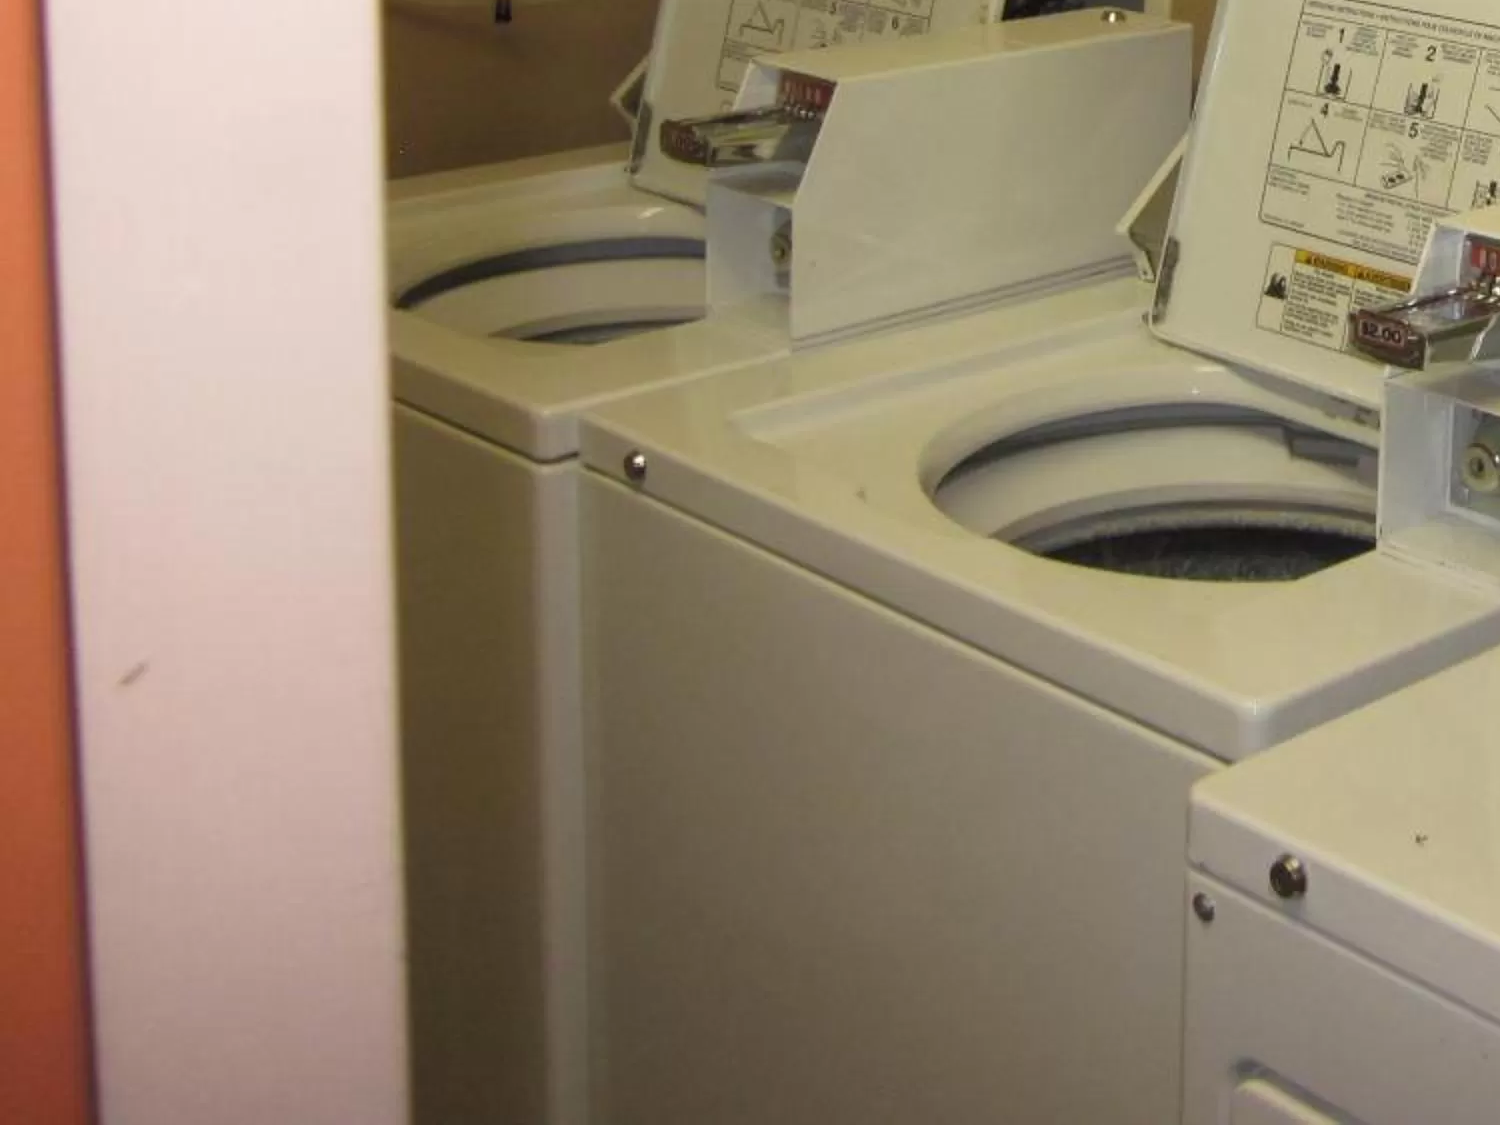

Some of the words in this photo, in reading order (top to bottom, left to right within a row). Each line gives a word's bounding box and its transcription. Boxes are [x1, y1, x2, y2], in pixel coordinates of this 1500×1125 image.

[1425, 44, 1437, 62] 2
[1408, 122, 1419, 139] 5
[1361, 322, 1402, 345] $2.00
